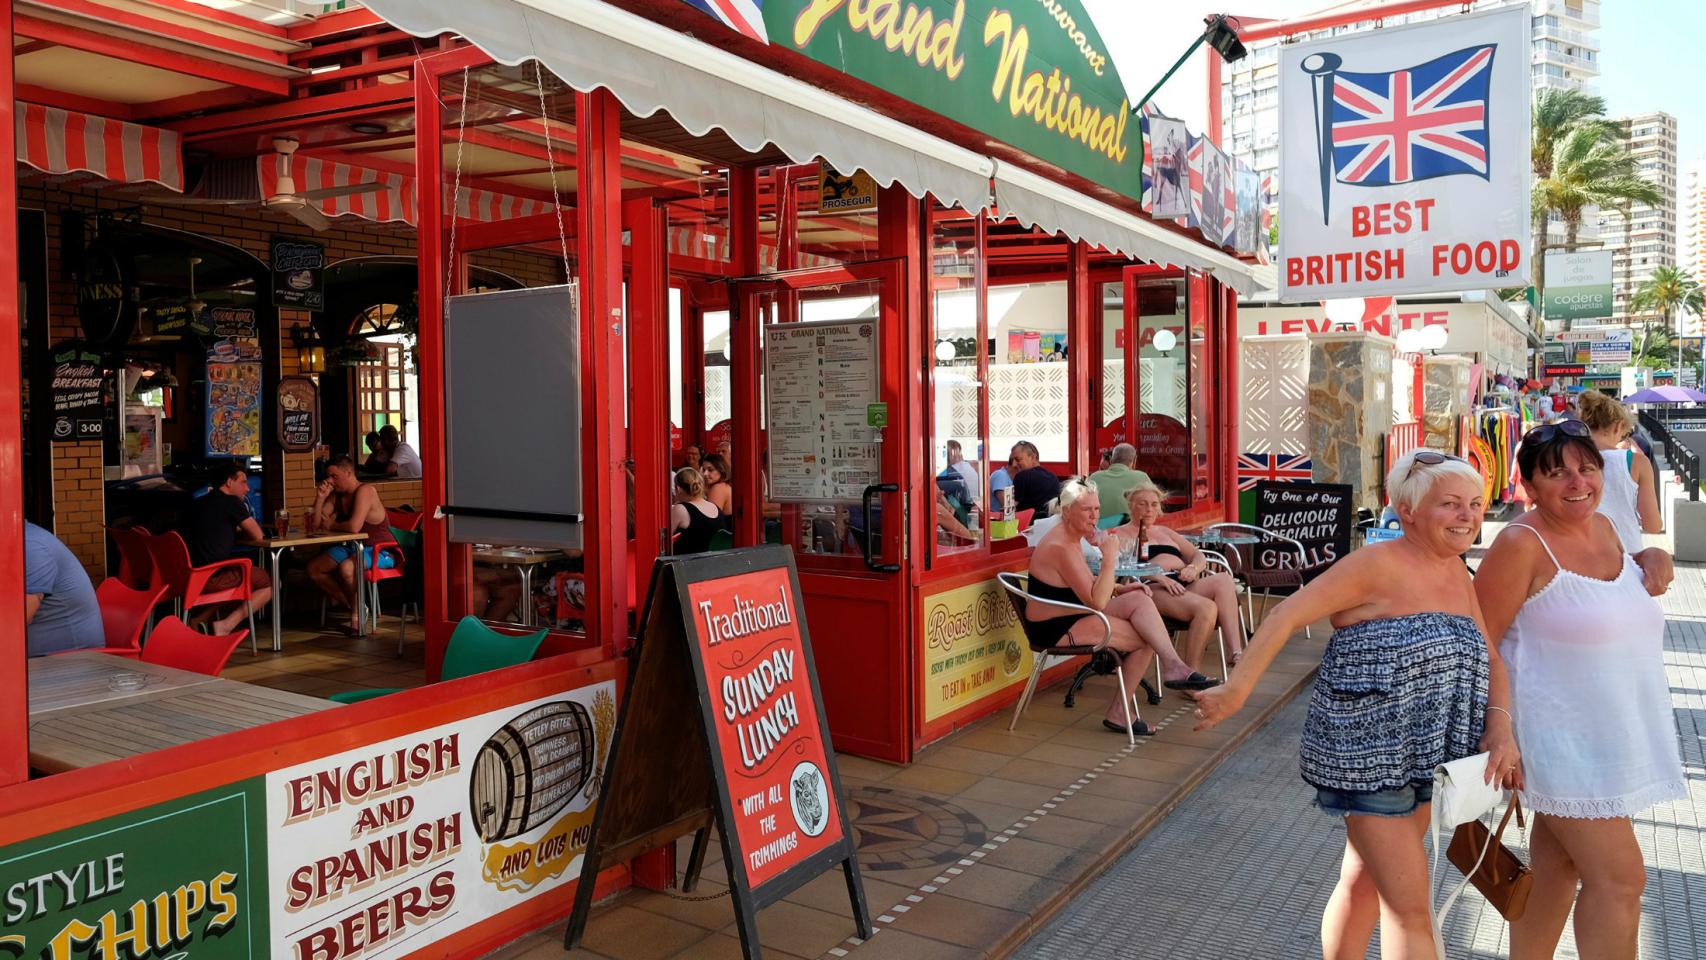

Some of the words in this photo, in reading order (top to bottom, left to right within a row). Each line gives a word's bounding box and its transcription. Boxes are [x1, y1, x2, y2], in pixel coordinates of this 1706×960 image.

[1037, 0, 1105, 76] aurant
[984, 7, 1128, 163] National
[823, 196, 871, 209] PROSEGUR
[1352, 198, 1435, 238] BEST
[1287, 248, 1405, 287] BRITISH
[1432, 239, 1521, 277] FOOD
[1554, 293, 1603, 305] codere
[1570, 302, 1603, 311] apuestas
[770, 332, 787, 342] UK
[791, 328, 814, 338] GRAND
[816, 326, 850, 336] NATIONAL
[1257, 311, 1448, 337] LEVNTE
[52, 378, 102, 389] BREAKFAST
[56, 362, 95, 378] English
[1263, 489, 1278, 504] Try
[1281, 491, 1302, 502] One
[1306, 492, 1319, 503] of
[1321, 493, 1343, 504] Our
[1262, 523, 1338, 544] SPECIALITY
[1263, 508, 1338, 528] DELICIOUS
[699, 584, 791, 644] Traditional
[928, 603, 973, 651] Roast
[721, 647, 795, 721] SUNDAY
[942, 683, 950, 701] TO
[950, 679, 960, 698] EAT
[960, 677, 967, 694] IN
[971, 671, 982, 689] TAKE
[983, 666, 995, 685] AWAY
[518, 711, 542, 728] CHOOSE
[543, 704, 561, 715] FROM
[525, 721, 550, 742] TETLEY
[550, 716, 572, 732] BITTER
[736, 691, 799, 767] LUNCH
[534, 736, 567, 756] GUINNESS
[538, 753, 550, 764] ON
[550, 742, 578, 761] DRAUGHT
[287, 732, 461, 820] ENGLISH
[533, 775, 545, 788] OLD
[538, 780, 571, 806] HEINEKEN
[355, 795, 415, 836] AND
[742, 790, 765, 817] WITH
[768, 783, 783, 804] ALL
[759, 814, 777, 836] THE
[287, 811, 463, 909] SPANISH
[500, 848, 531, 878] AND
[537, 832, 568, 864] LOTS
[570, 825, 591, 849] MO
[749, 831, 798, 872] TRIMMINGS
[6, 852, 125, 923] STYLE
[48, 870, 238, 960] CHIPS
[296, 870, 457, 960] BEERS
